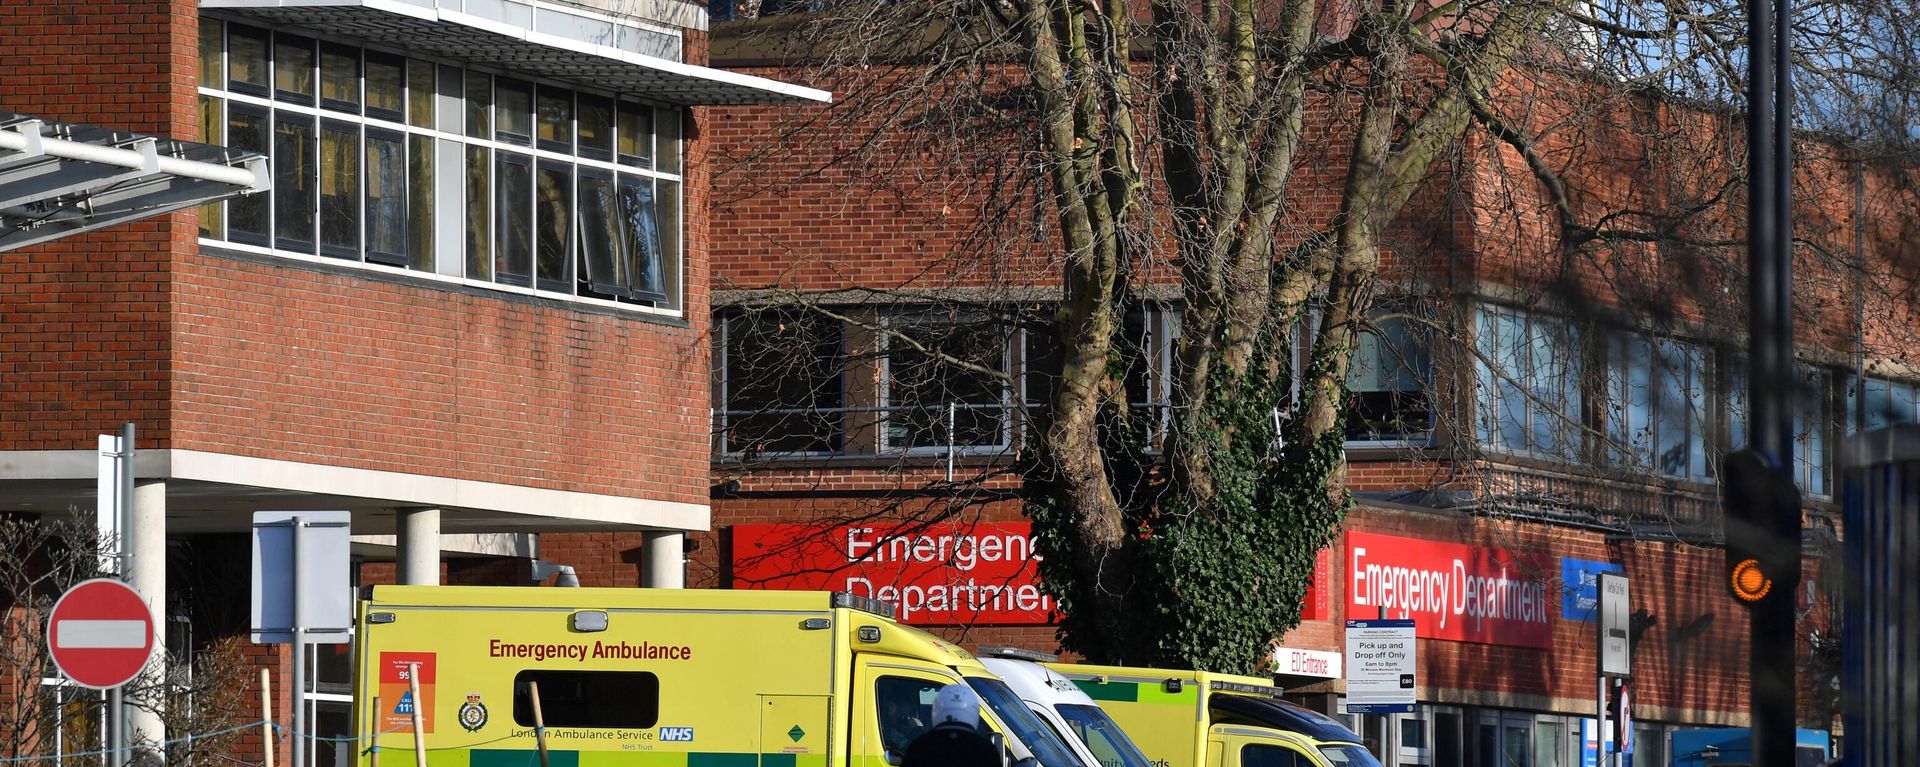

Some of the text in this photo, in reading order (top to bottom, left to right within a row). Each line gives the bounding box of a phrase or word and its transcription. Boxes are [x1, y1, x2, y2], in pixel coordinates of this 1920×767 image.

[848, 528, 1044, 571] Emergenc
[846, 577, 1063, 621] Departme
[1354, 547, 1449, 629] Emergency
[1453, 559, 1547, 632] Department
[489, 639, 691, 661] Emergency Ambulance
[1355, 651, 1406, 660] Drop off Only
[1292, 651, 1328, 674] ED Entrance
[511, 727, 693, 741] Londn Ambulance Service NHS
